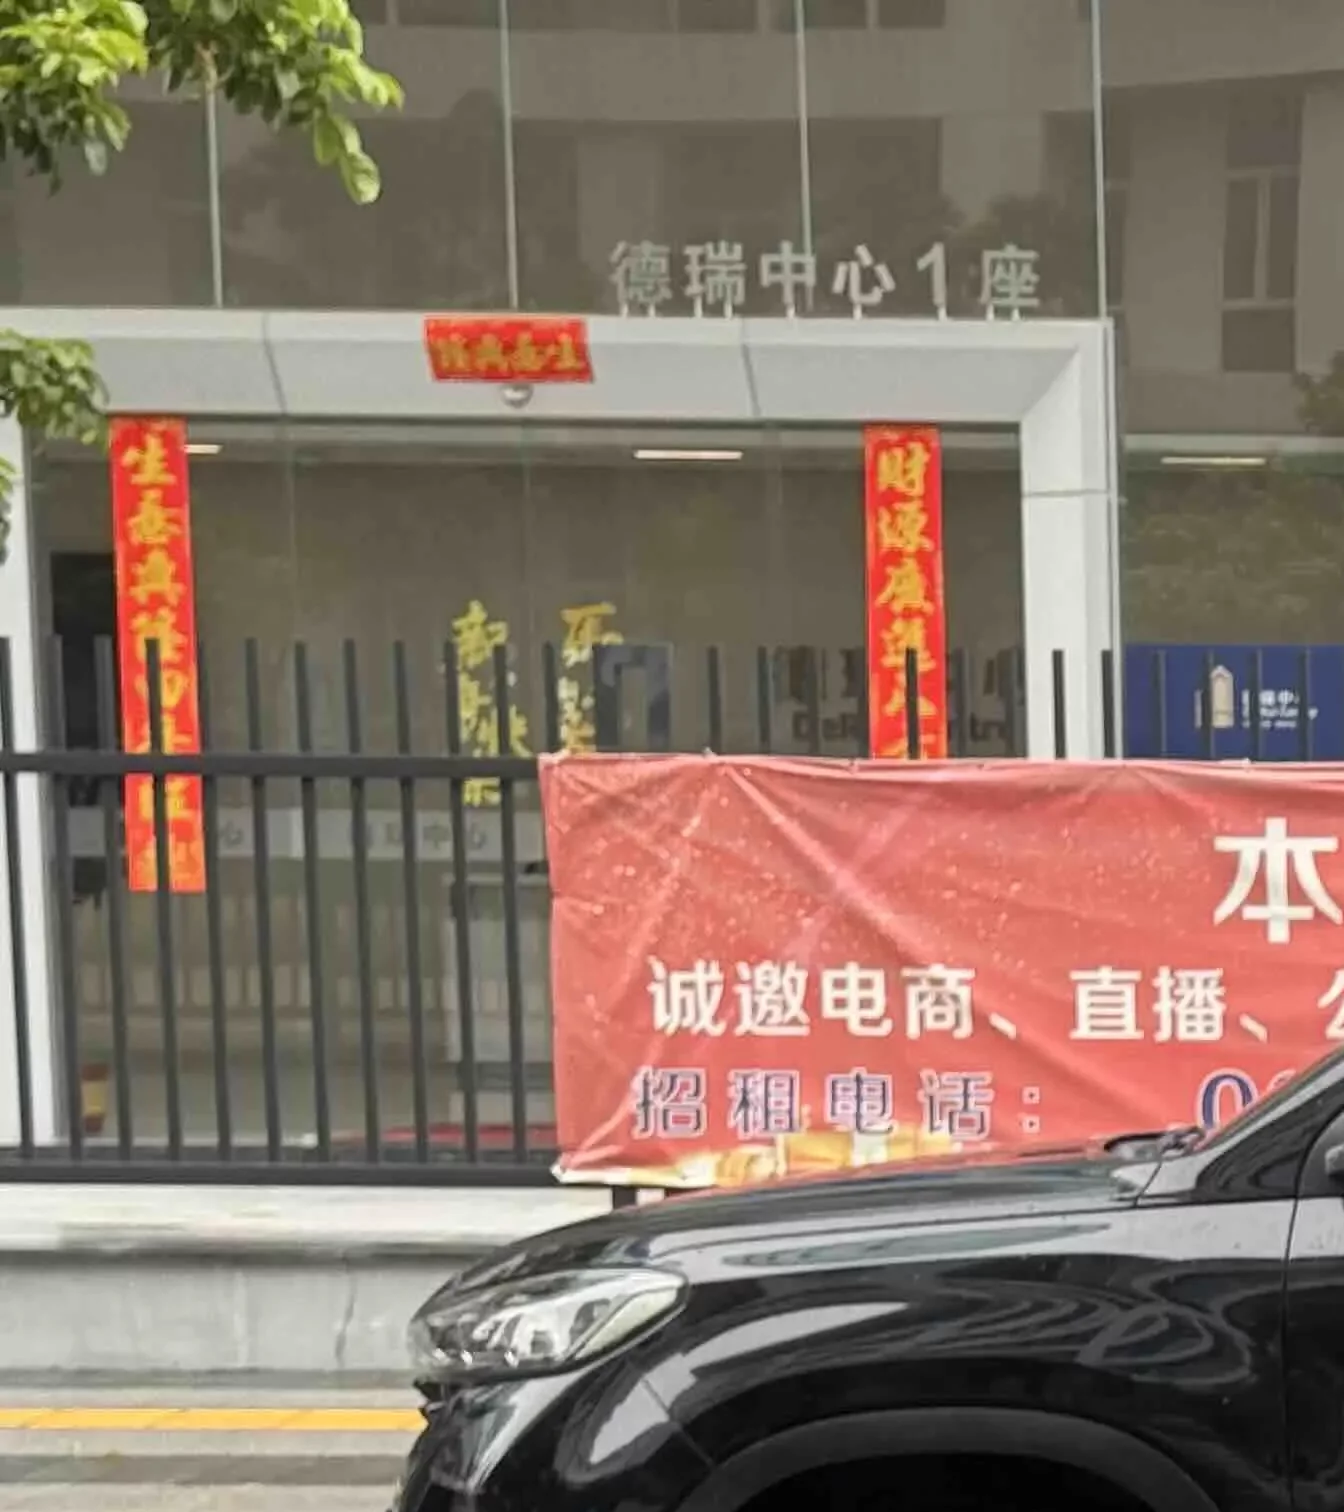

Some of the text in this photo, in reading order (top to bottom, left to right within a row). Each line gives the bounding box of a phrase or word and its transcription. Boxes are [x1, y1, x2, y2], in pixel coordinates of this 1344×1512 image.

[609, 240, 1040, 307] 德瑞中心1座
